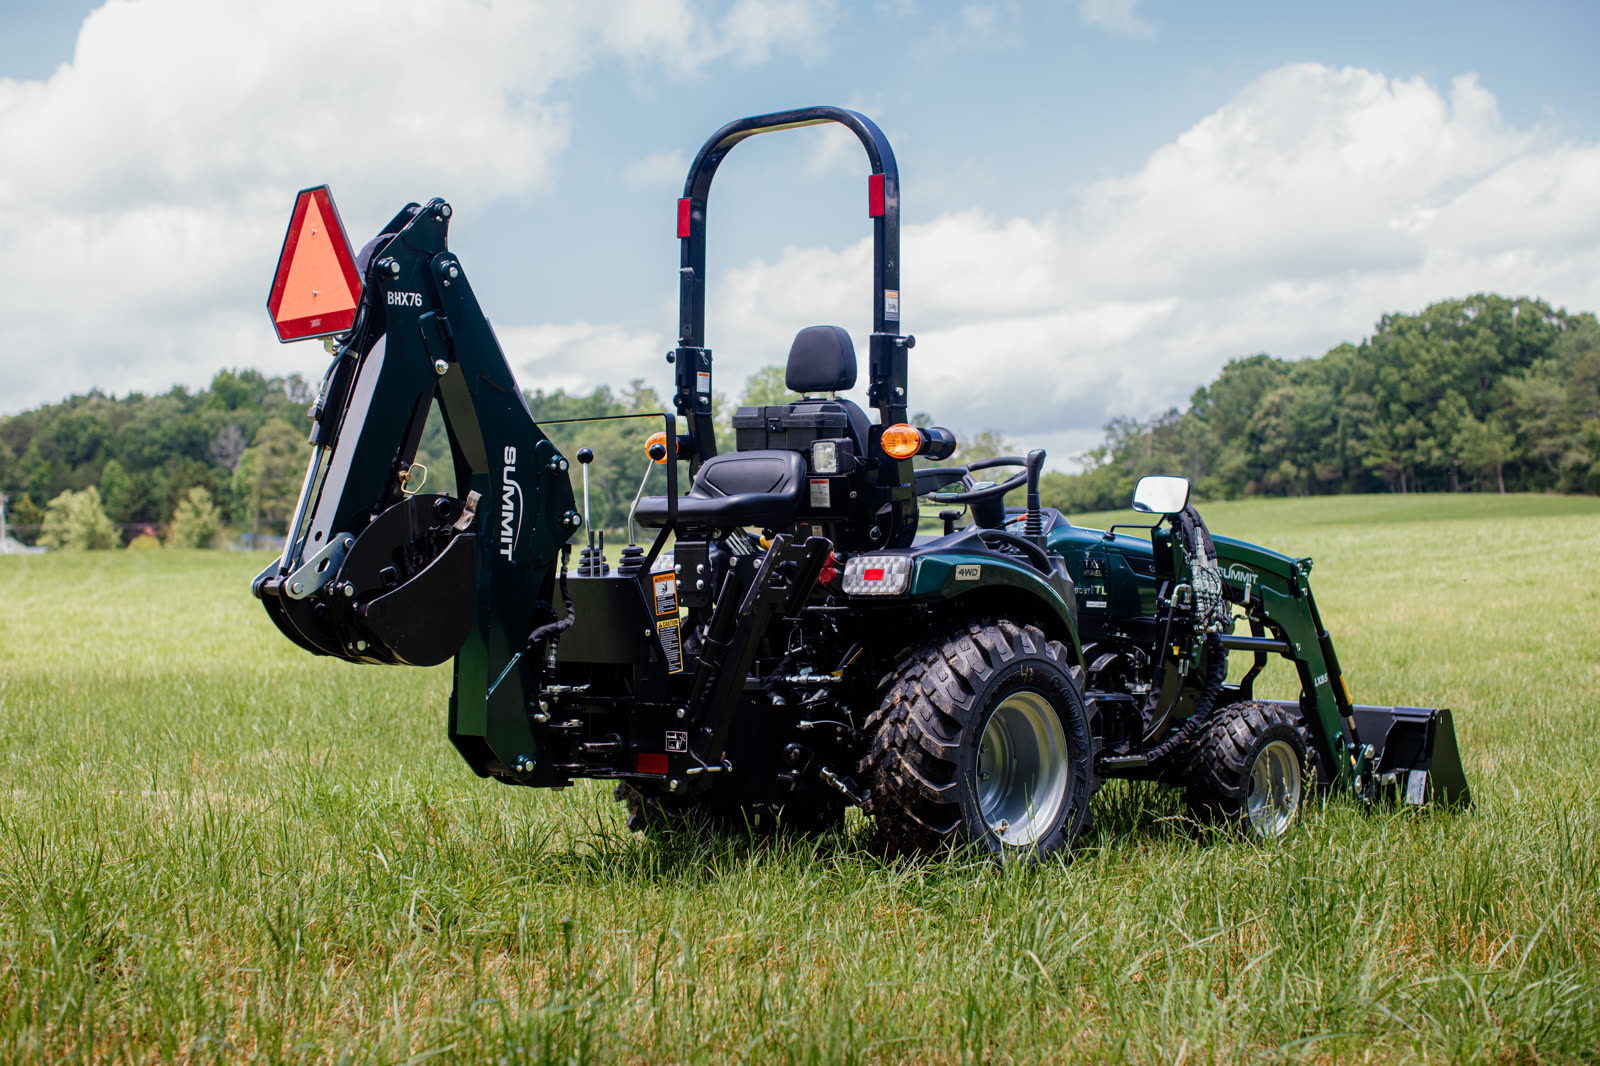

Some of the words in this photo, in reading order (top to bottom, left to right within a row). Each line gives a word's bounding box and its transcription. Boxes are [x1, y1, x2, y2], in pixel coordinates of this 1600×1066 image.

[387, 291, 423, 307] BHX76
[500, 446, 523, 561] SUMMIT
[958, 567, 979, 577] 4WD
[663, 618, 678, 628] CAUTION
